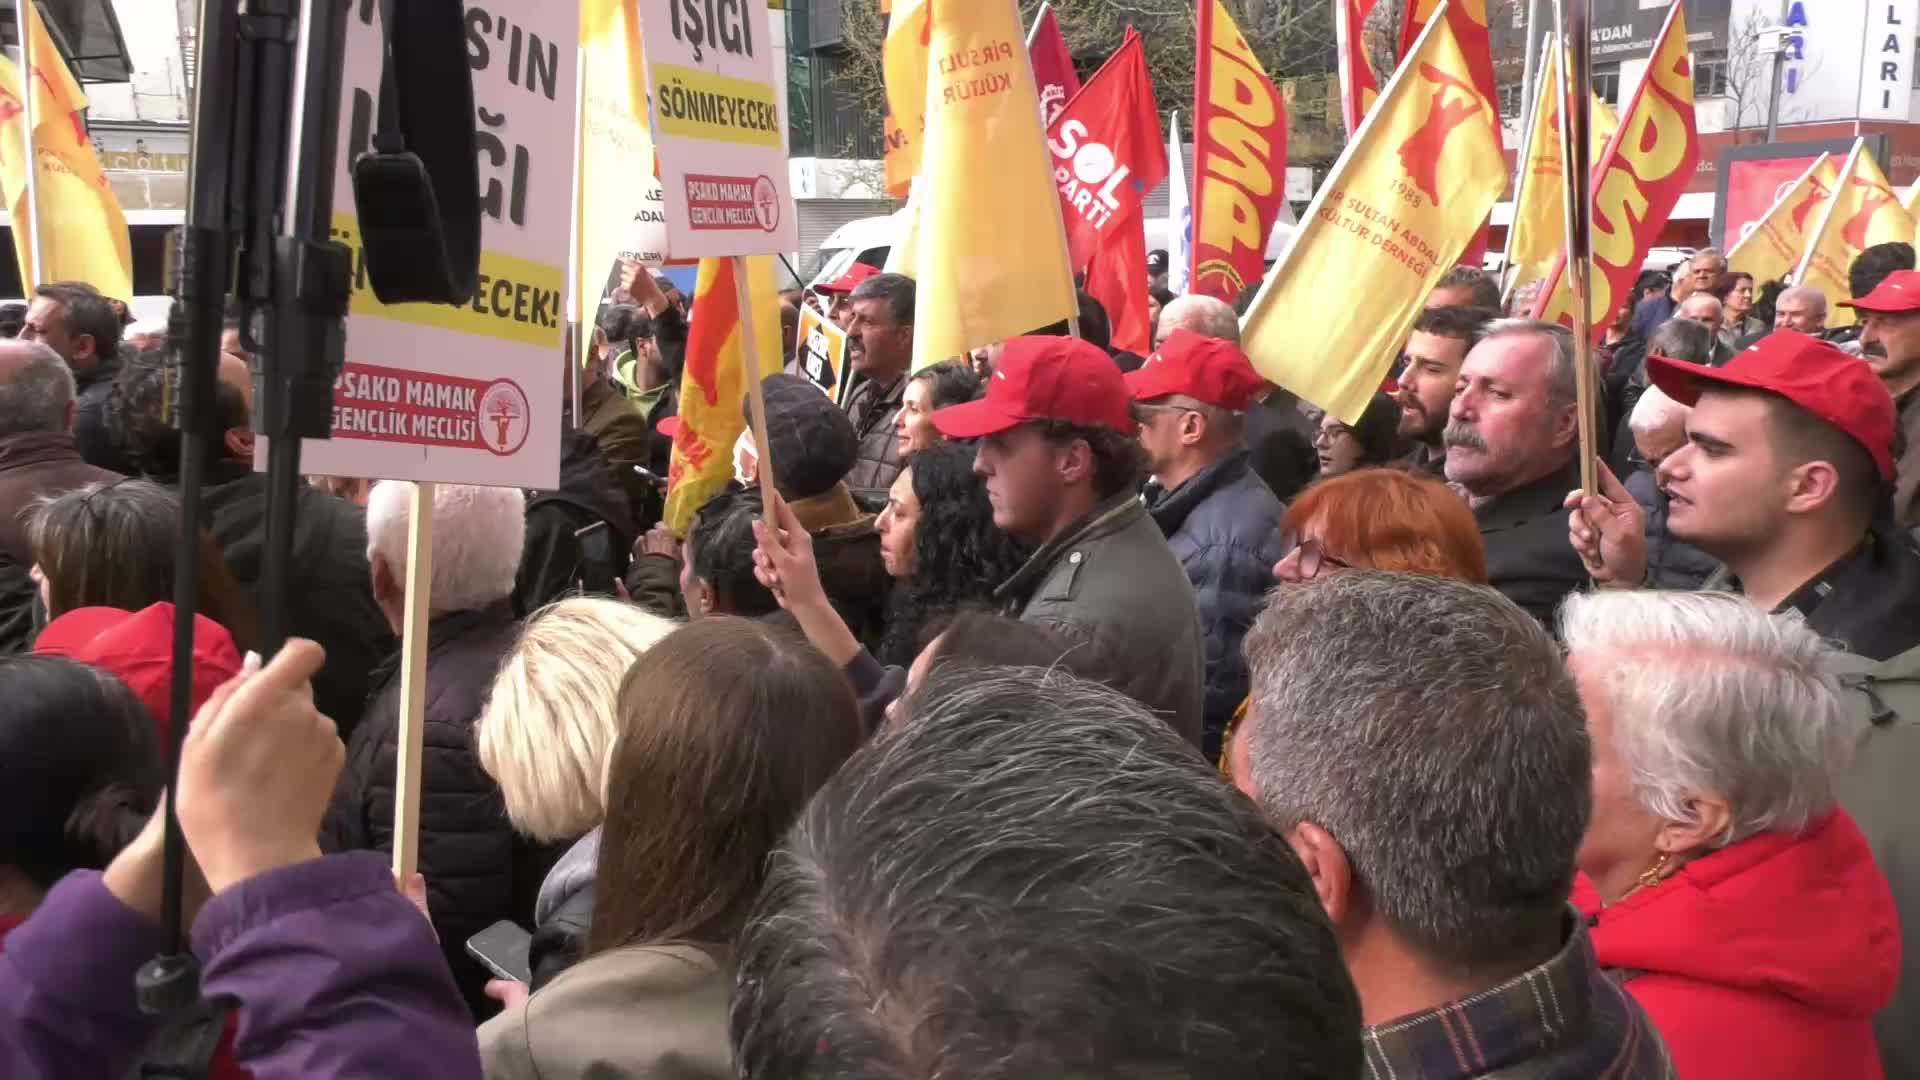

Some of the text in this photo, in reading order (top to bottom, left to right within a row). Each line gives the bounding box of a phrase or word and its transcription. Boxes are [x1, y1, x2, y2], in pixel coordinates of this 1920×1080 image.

[659, 77, 778, 132] SÖNMEYECEK!
[1047, 119, 1130, 210] SOL
[1346, 198, 1401, 232] SULTAN
[1400, 230, 1441, 266] ABDAL
[406, 379, 477, 412] MAMAK
[412, 413, 477, 442] MECLİSİ
